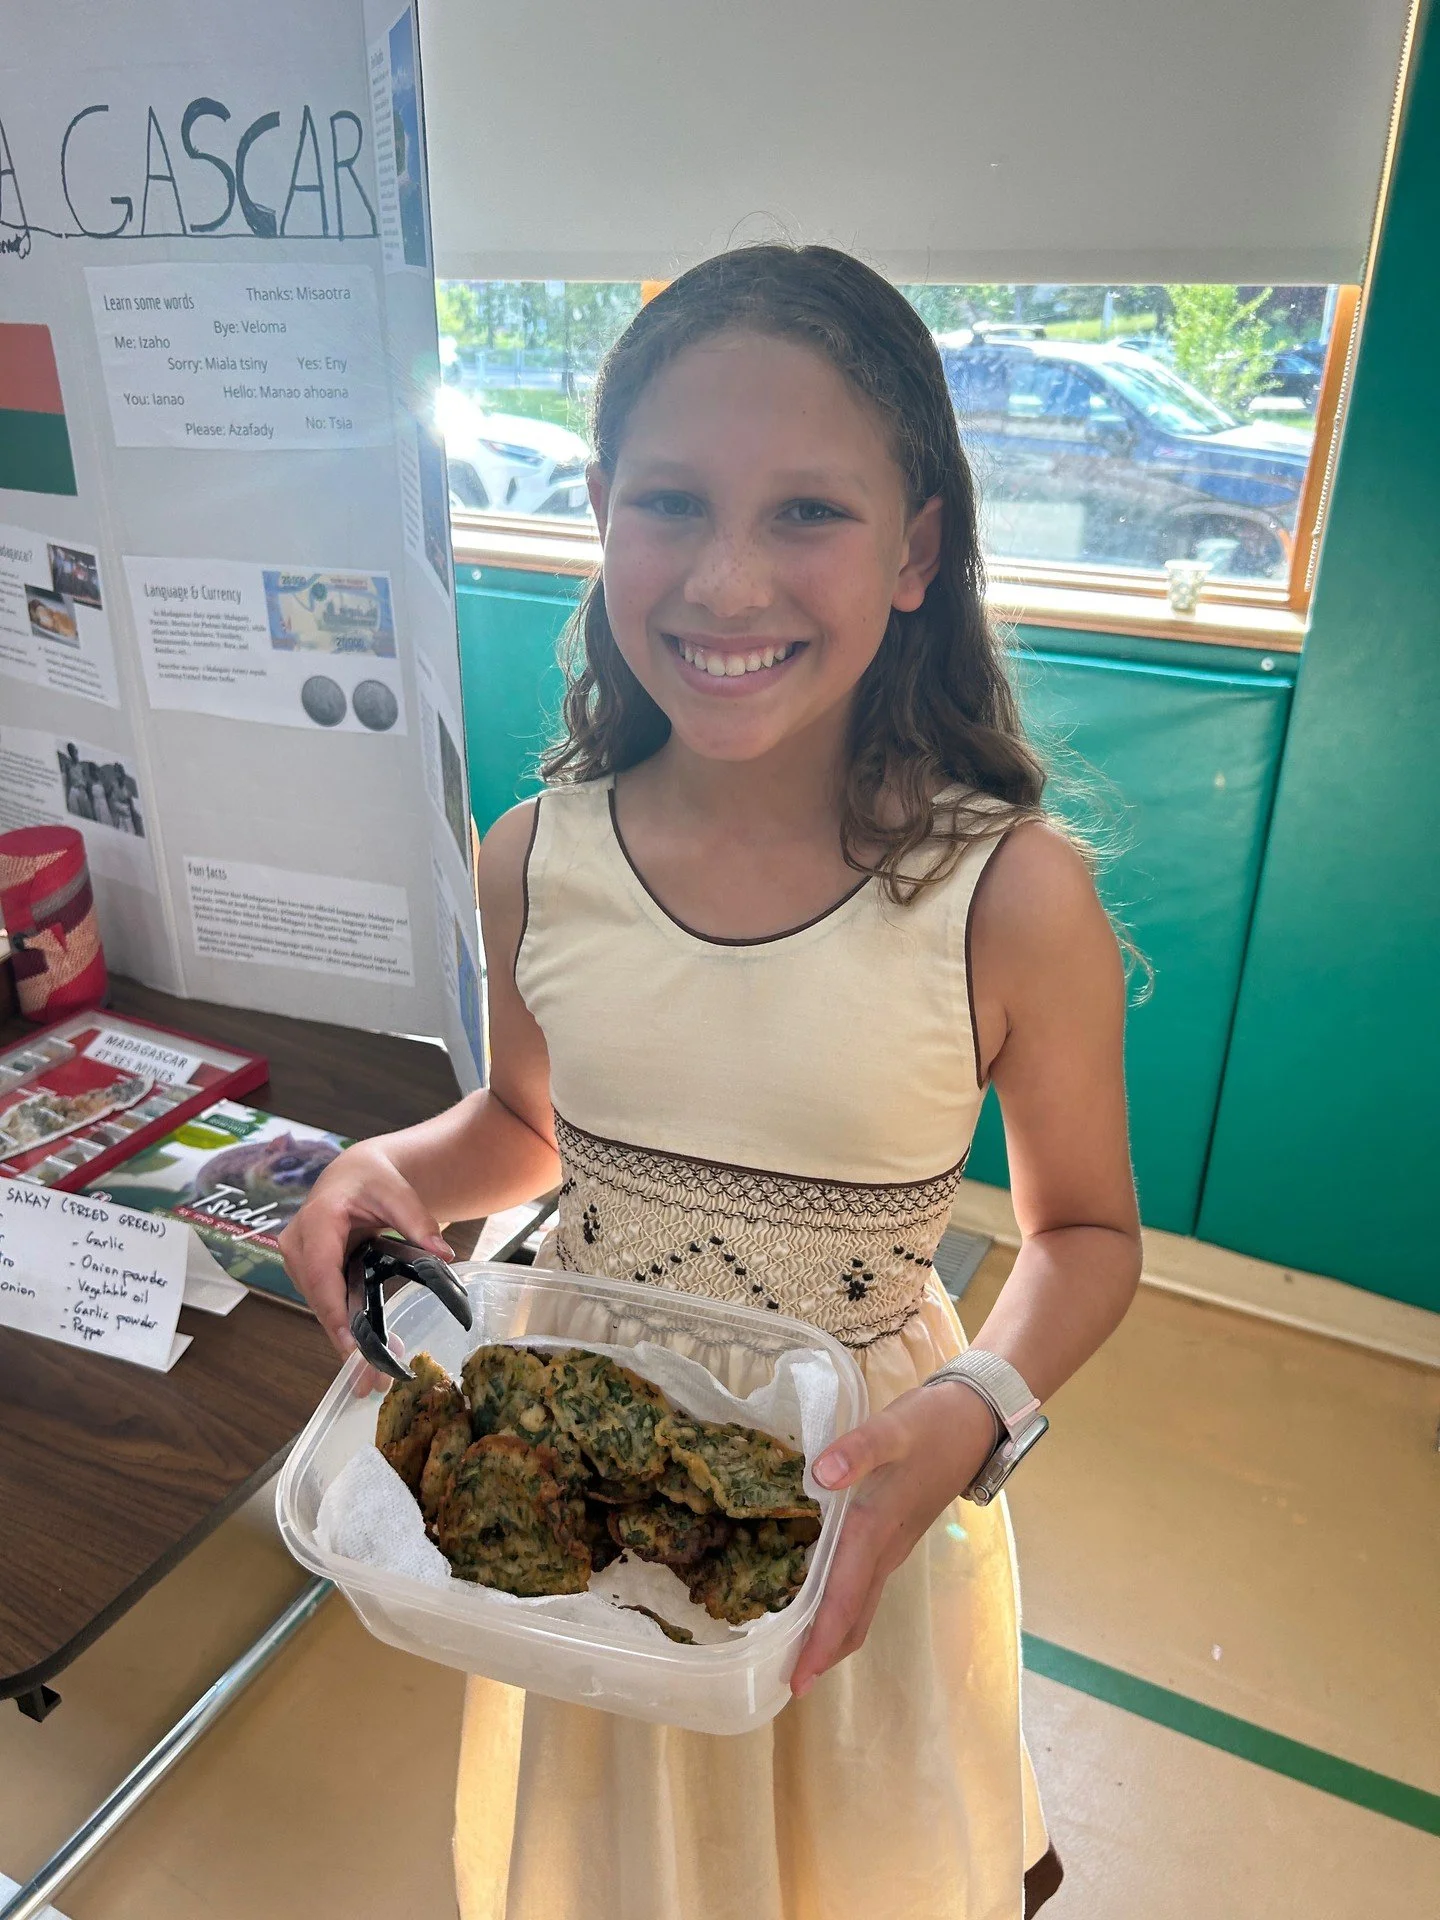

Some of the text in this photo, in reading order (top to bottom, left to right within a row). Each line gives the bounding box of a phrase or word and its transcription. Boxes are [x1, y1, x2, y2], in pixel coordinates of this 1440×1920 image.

[103, 293, 195, 311] Learn some words
[246, 287, 351, 302] Thanks: Misaotra
[213, 320, 287, 337] Bye: Veloma
[114, 336, 171, 349] Me: Izaho
[168, 357, 268, 374] Sorry: Miala tsiny
[297, 356, 348, 373] Yes: Eny
[123, 393, 185, 406] You: Ianao
[223, 385, 350, 399] Hello: Manao ahoana
[185, 423, 274, 439] Please: Azafady
[305, 416, 353, 430] No: Tsia
[144, 582, 188, 602] Language
[201, 584, 242, 605] Currency
[105, 1035, 189, 1068] MADAGASCAR
[6, 1187, 51, 1210] SAKAY
[118, 1213, 166, 1238] GREEN)
[192, 1183, 282, 1241] Tsidy
[86, 1231, 125, 1251] Garlic
[82, 1254, 168, 1288] Onion powder
[1, 1281, 36, 1299] onion
[78, 1279, 149, 1305] Vegetable oil
[74, 1301, 160, 1330] Garlic powder
[72, 1316, 105, 1341] Pepper
